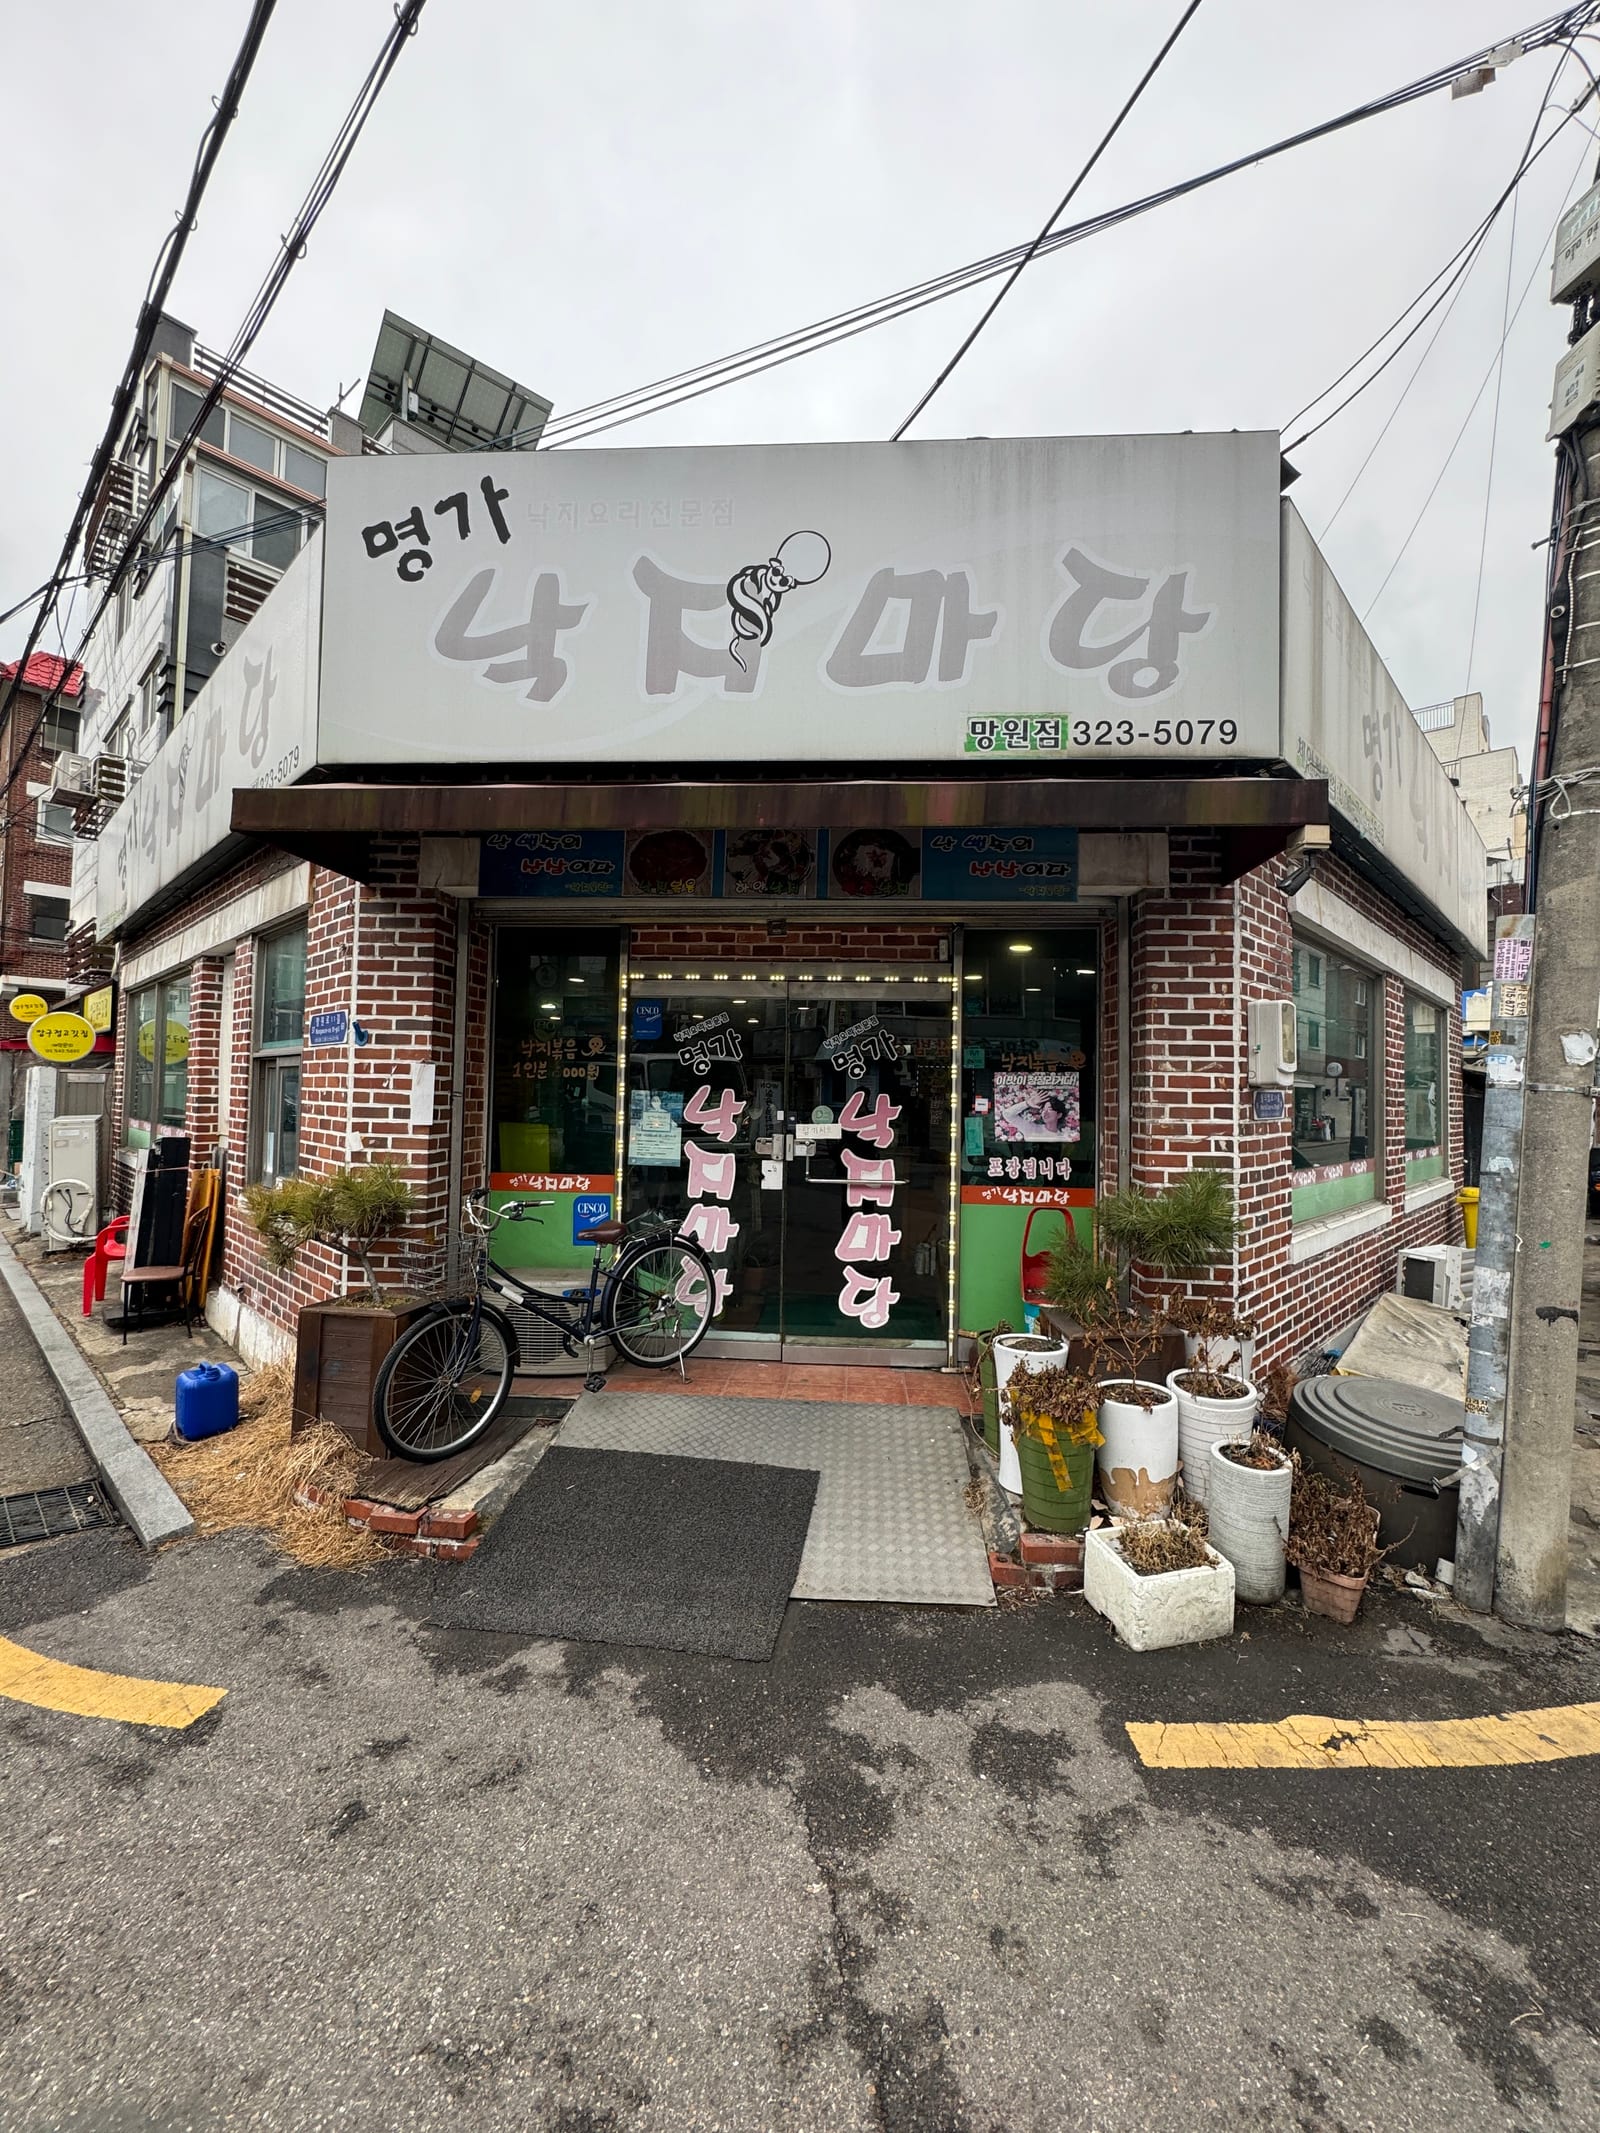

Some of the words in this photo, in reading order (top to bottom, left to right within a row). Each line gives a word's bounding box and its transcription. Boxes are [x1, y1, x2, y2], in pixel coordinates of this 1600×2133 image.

[361, 475, 512, 583] 명가
[527, 498, 735, 529] 낙지요리전문점
[434, 546, 1212, 703] 낙지마당
[968, 717, 1063, 752] 망원점
[1072, 718, 1239, 746] 323-5079
[1362, 704, 1401, 802] 명가
[118, 798, 138, 891] 명가
[636, 1006, 659, 1015] CESCO
[519, 1038, 579, 1061] 낙지볶음
[678, 1028, 744, 1076] 명가
[831, 1028, 898, 1080] 명가
[512, 1060, 548, 1080] 1인분
[509, 1173, 528, 1187] 명가
[528, 1175, 592, 1191] 낙지마당
[987, 1156, 1073, 1181] 포장됩니다
[577, 1202, 607, 1214] CESCO
[834, 1090, 903, 1329] 낙지마당
[981, 1186, 1001, 1200] 명가
[1002, 1188, 1070, 1205] 낙지마당
